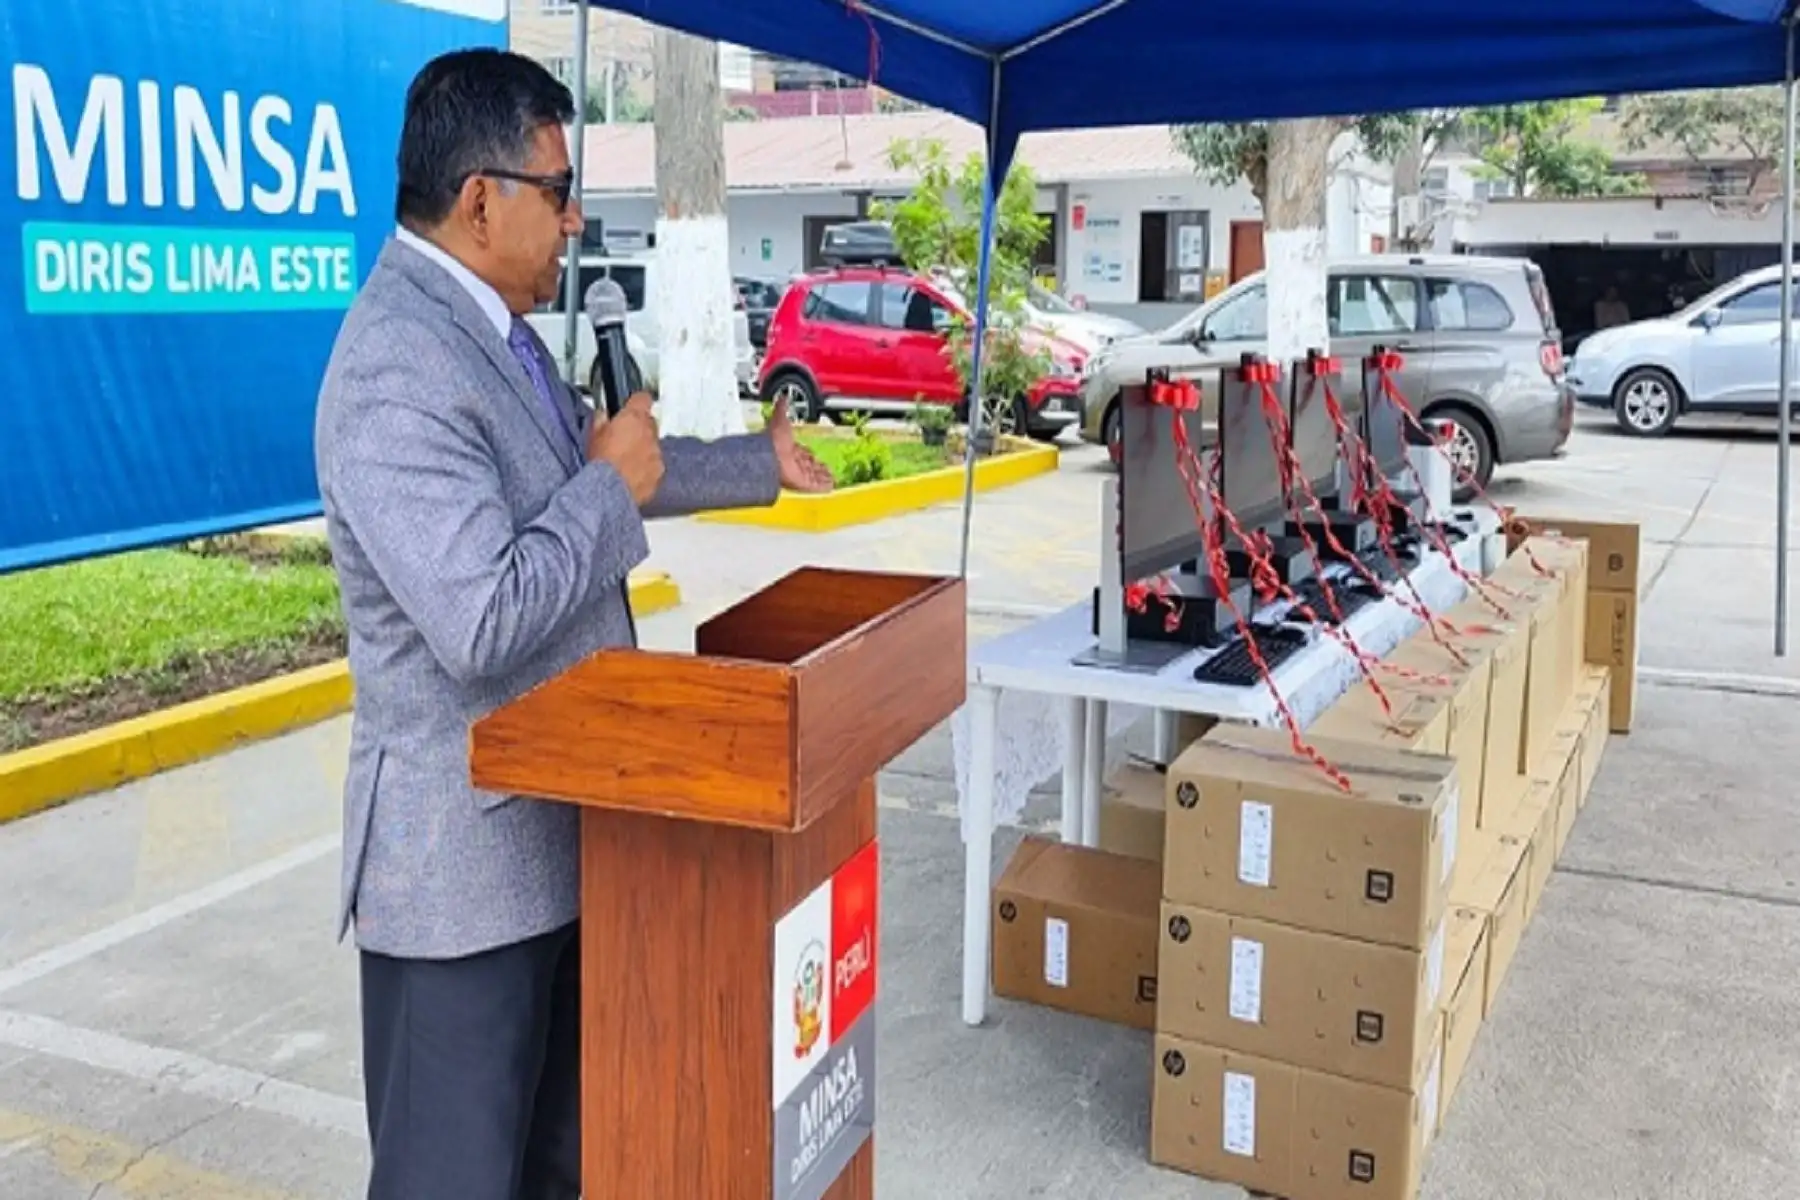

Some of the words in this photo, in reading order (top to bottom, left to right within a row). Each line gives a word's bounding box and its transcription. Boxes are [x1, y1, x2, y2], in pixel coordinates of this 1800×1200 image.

[12, 62, 358, 217] MINSA
[35, 238, 155, 294] DIRIS
[166, 242, 262, 294] LIMA
[270, 244, 353, 293] ESTE
[835, 924, 871, 998] PERÚ
[800, 1046, 857, 1146] MINSA
